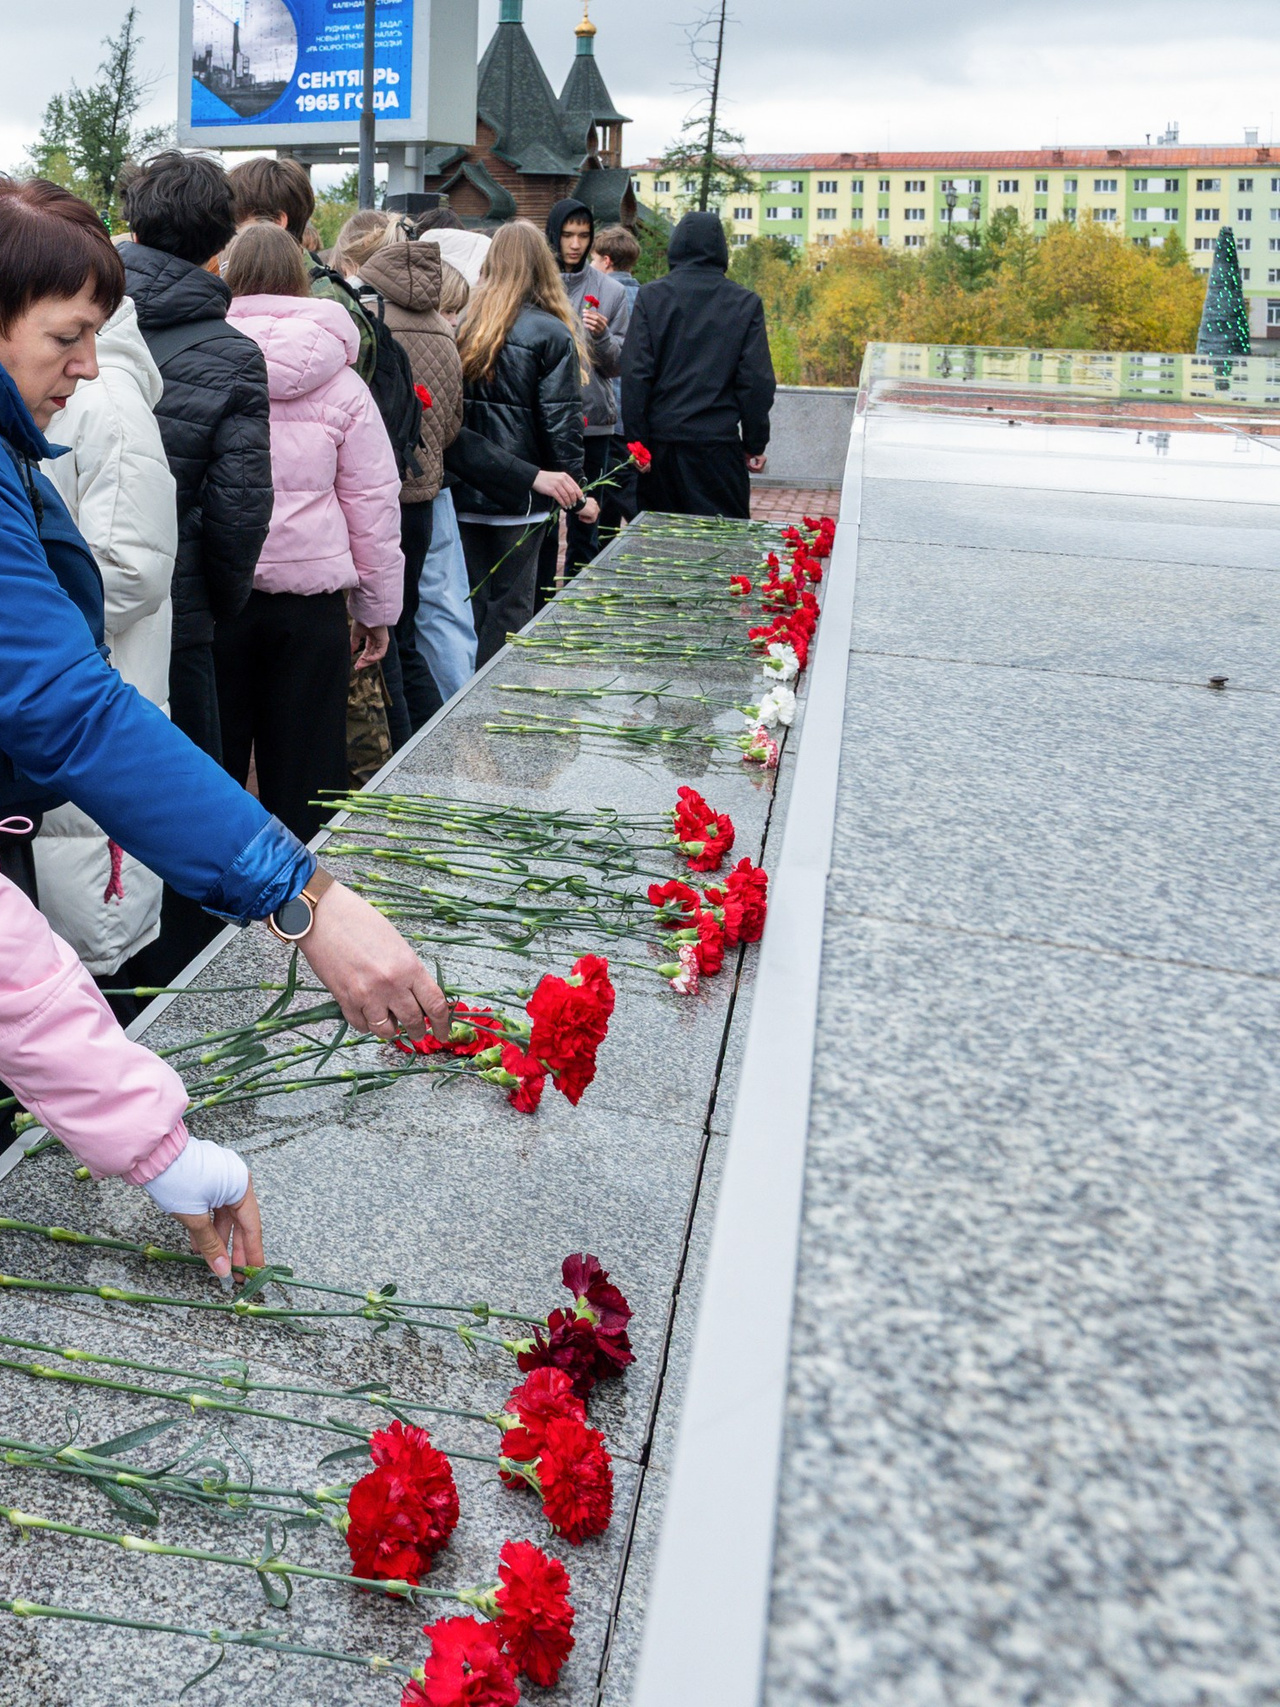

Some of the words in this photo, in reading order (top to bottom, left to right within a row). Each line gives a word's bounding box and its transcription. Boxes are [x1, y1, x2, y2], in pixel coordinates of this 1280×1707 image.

[315, 34, 340, 42] НОВЫЙ
[297, 67, 400, 90] СЕНТЯРЬ
[295, 93, 340, 112] 1965
[344, 90, 399, 112] ГОДА
